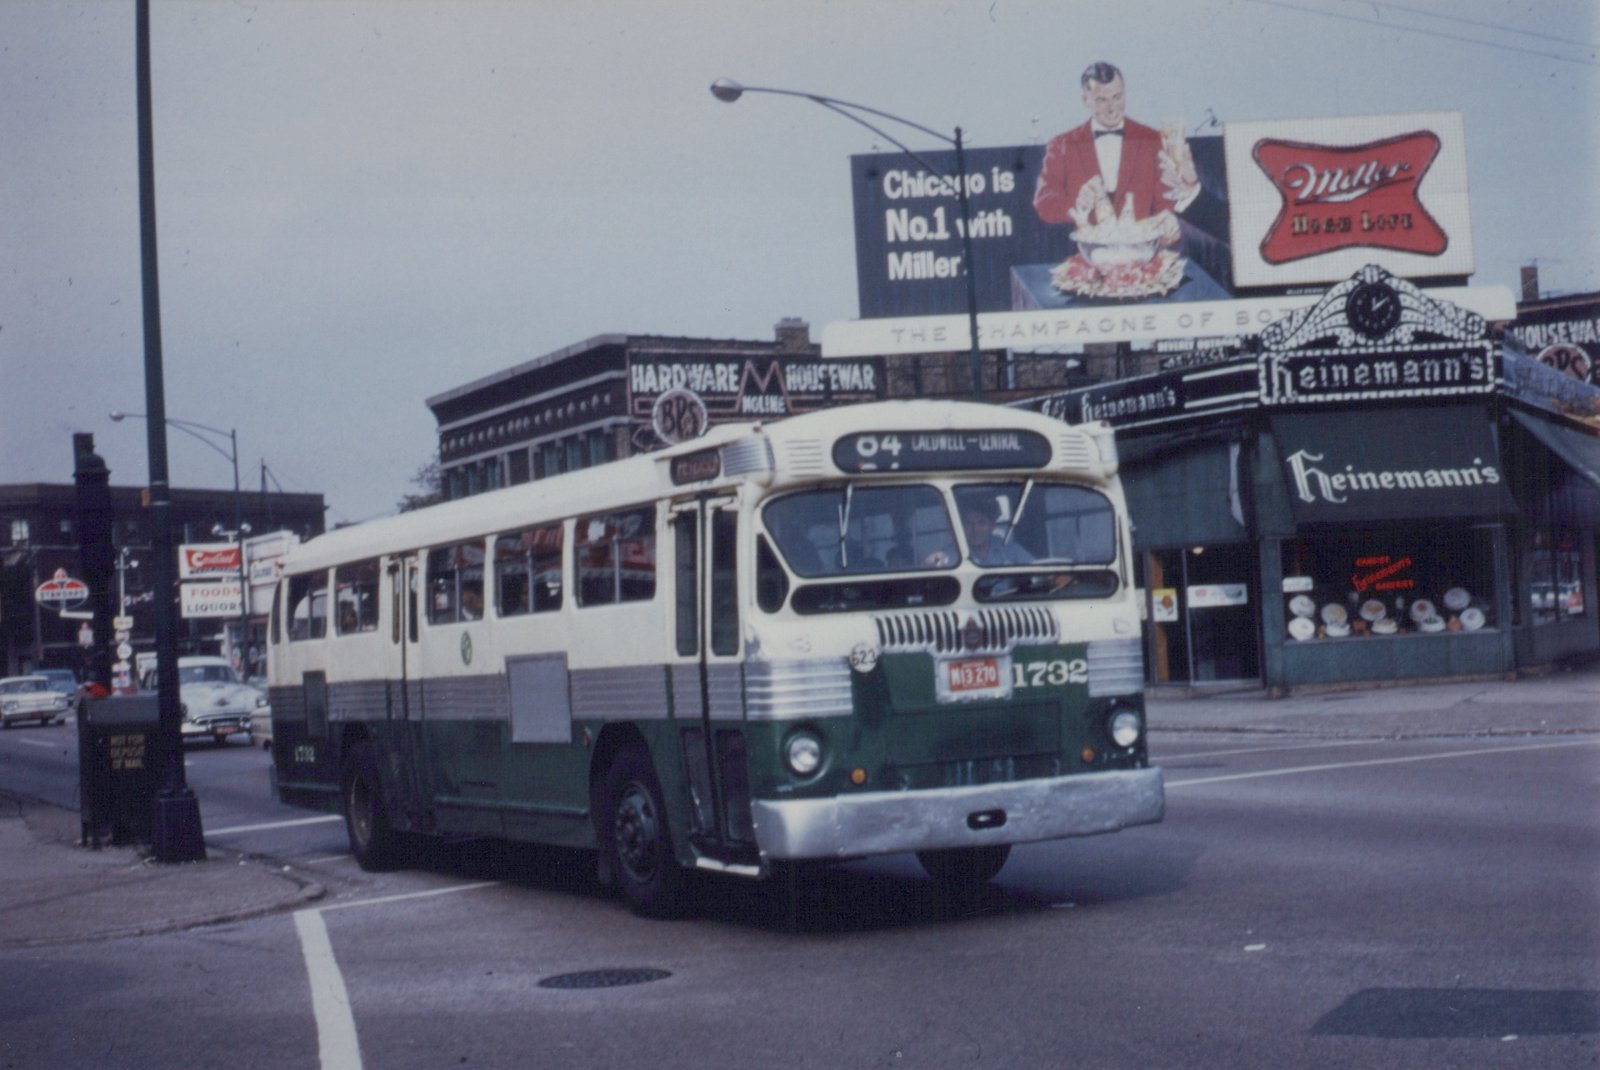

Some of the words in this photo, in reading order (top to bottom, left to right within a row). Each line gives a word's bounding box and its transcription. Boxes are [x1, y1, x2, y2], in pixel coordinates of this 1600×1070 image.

[883, 169, 985, 200] Chicago
[992, 166, 1015, 193] is
[1283, 160, 1410, 201] Miller
[886, 206, 949, 242] No.1
[955, 208, 1012, 238] with
[890, 326, 947, 343] THE
[1177, 311, 1214, 329] OF
[1513, 318, 1600, 349] OUSEWA
[631, 363, 739, 393] HARDWARE
[1286, 449, 1500, 503] Heinemann's
[191, 586, 241, 599] FOODS
[1013, 659, 1088, 688] 1732
